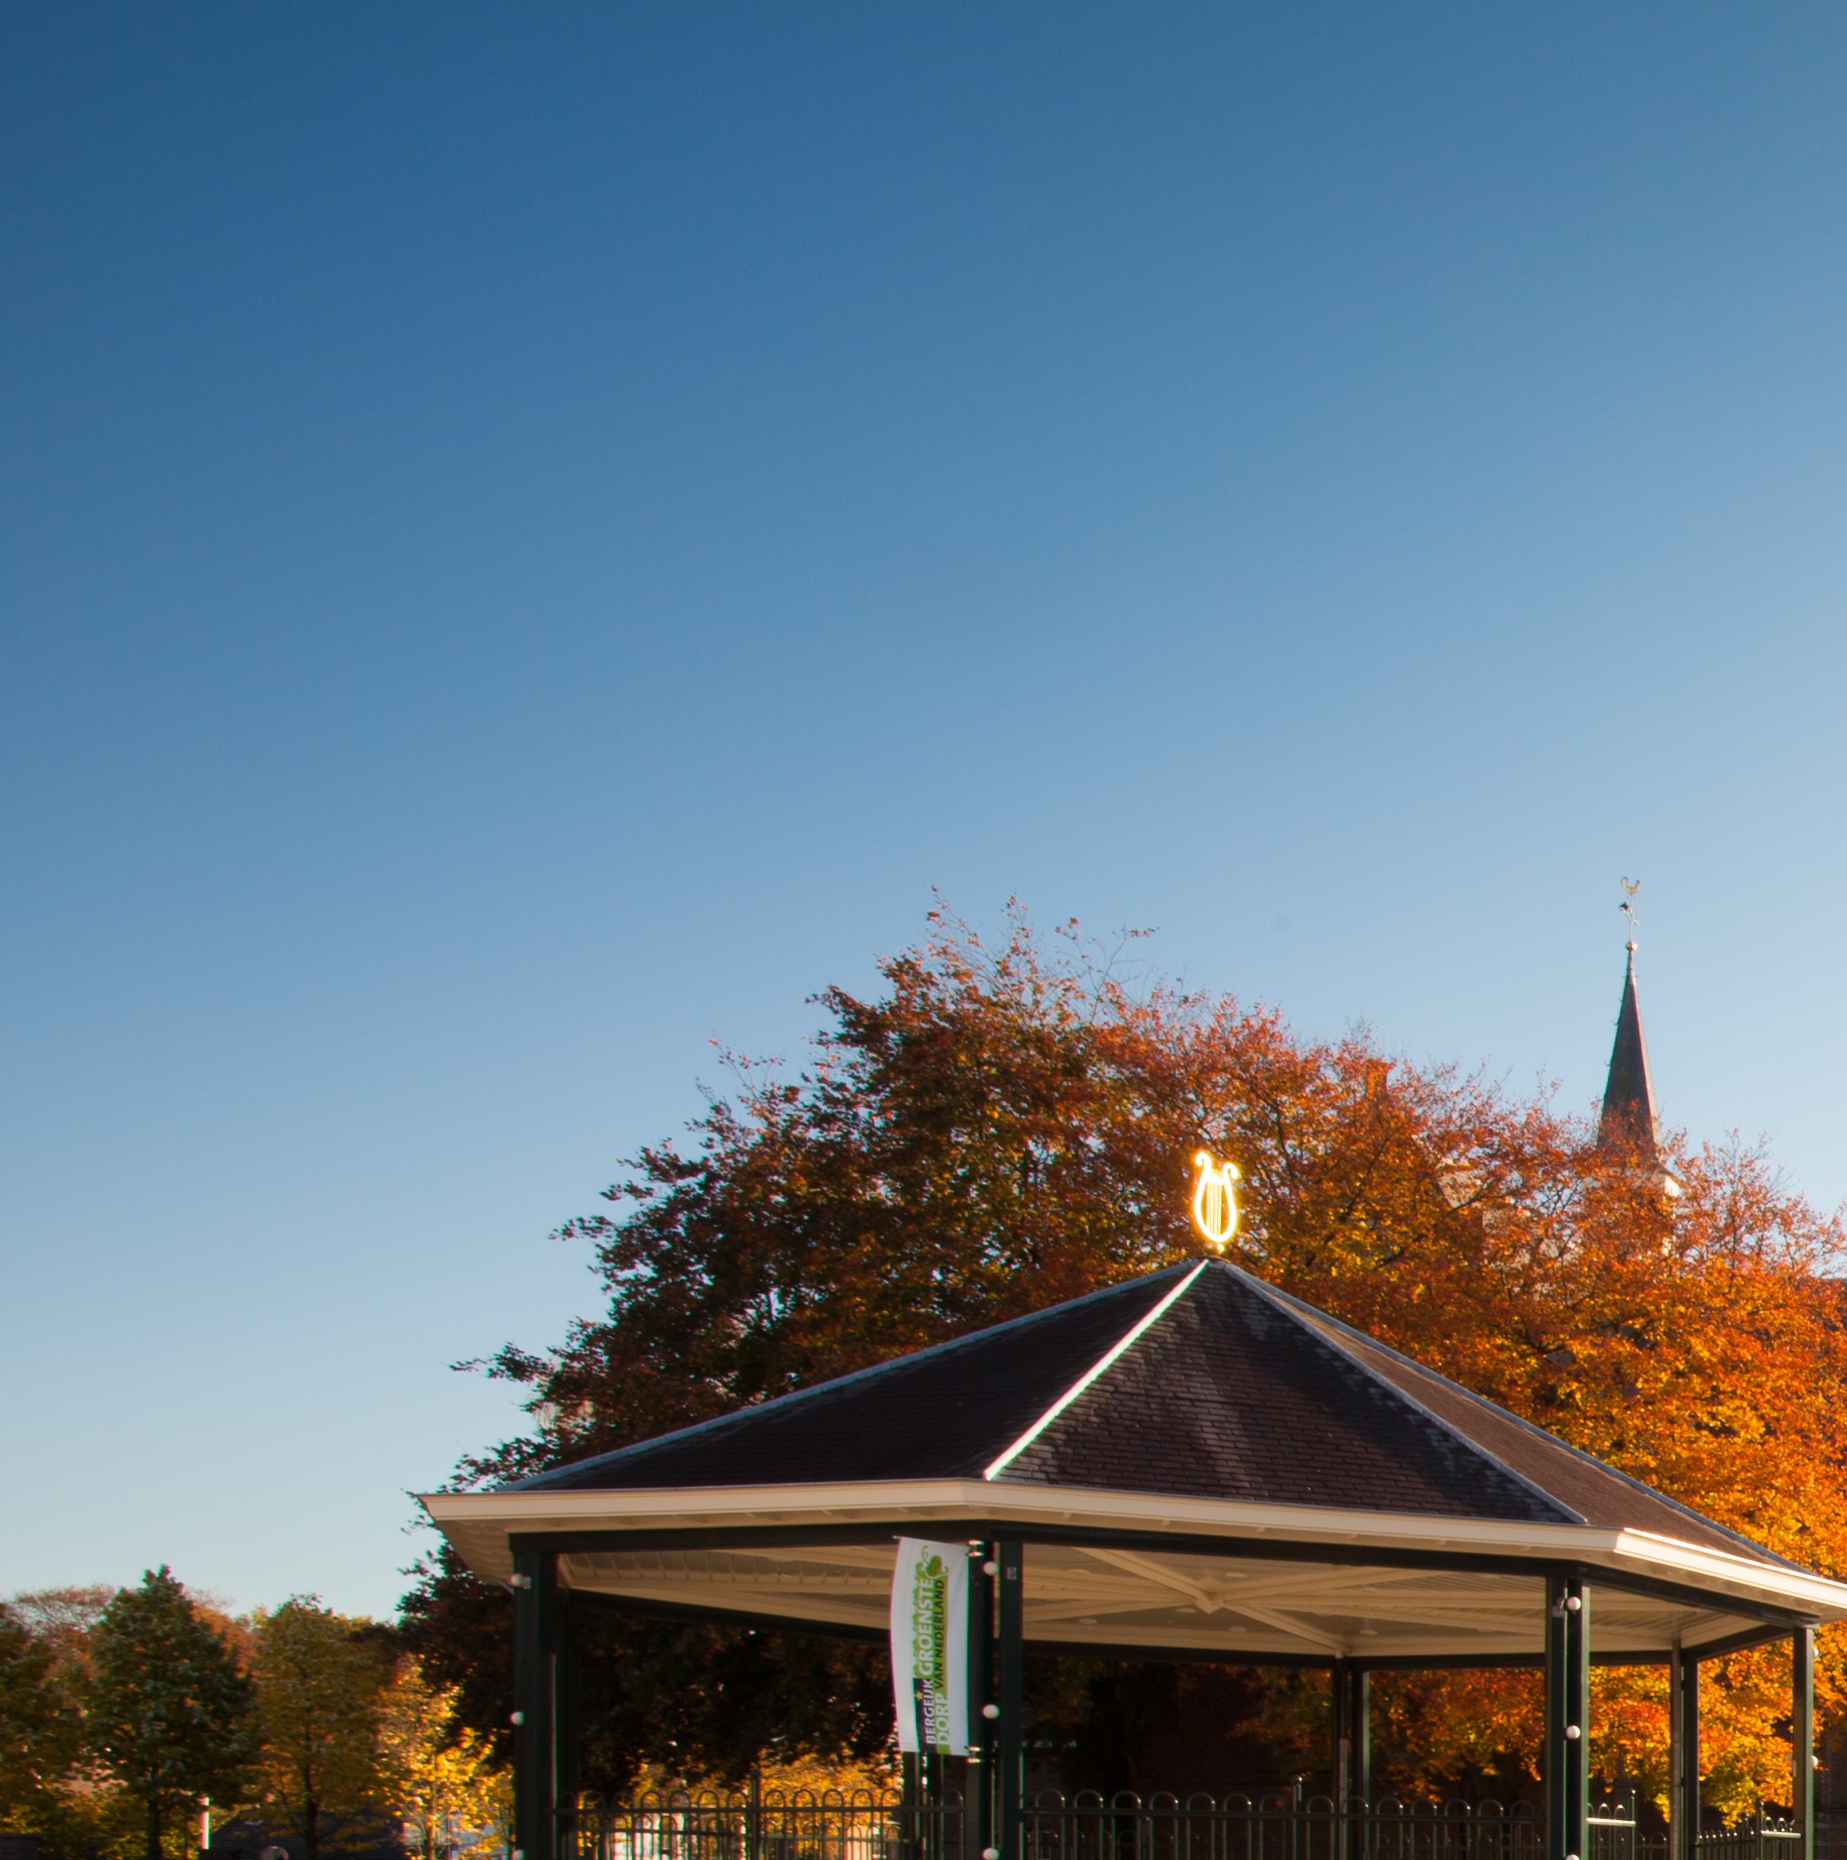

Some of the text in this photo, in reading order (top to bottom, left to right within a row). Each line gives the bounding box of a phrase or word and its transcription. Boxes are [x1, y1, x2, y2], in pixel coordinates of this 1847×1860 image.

[918, 1578, 937, 1745] BERGEIJK GROENSTE
[934, 1580, 949, 1746] DORP VAN NEDERLAND
